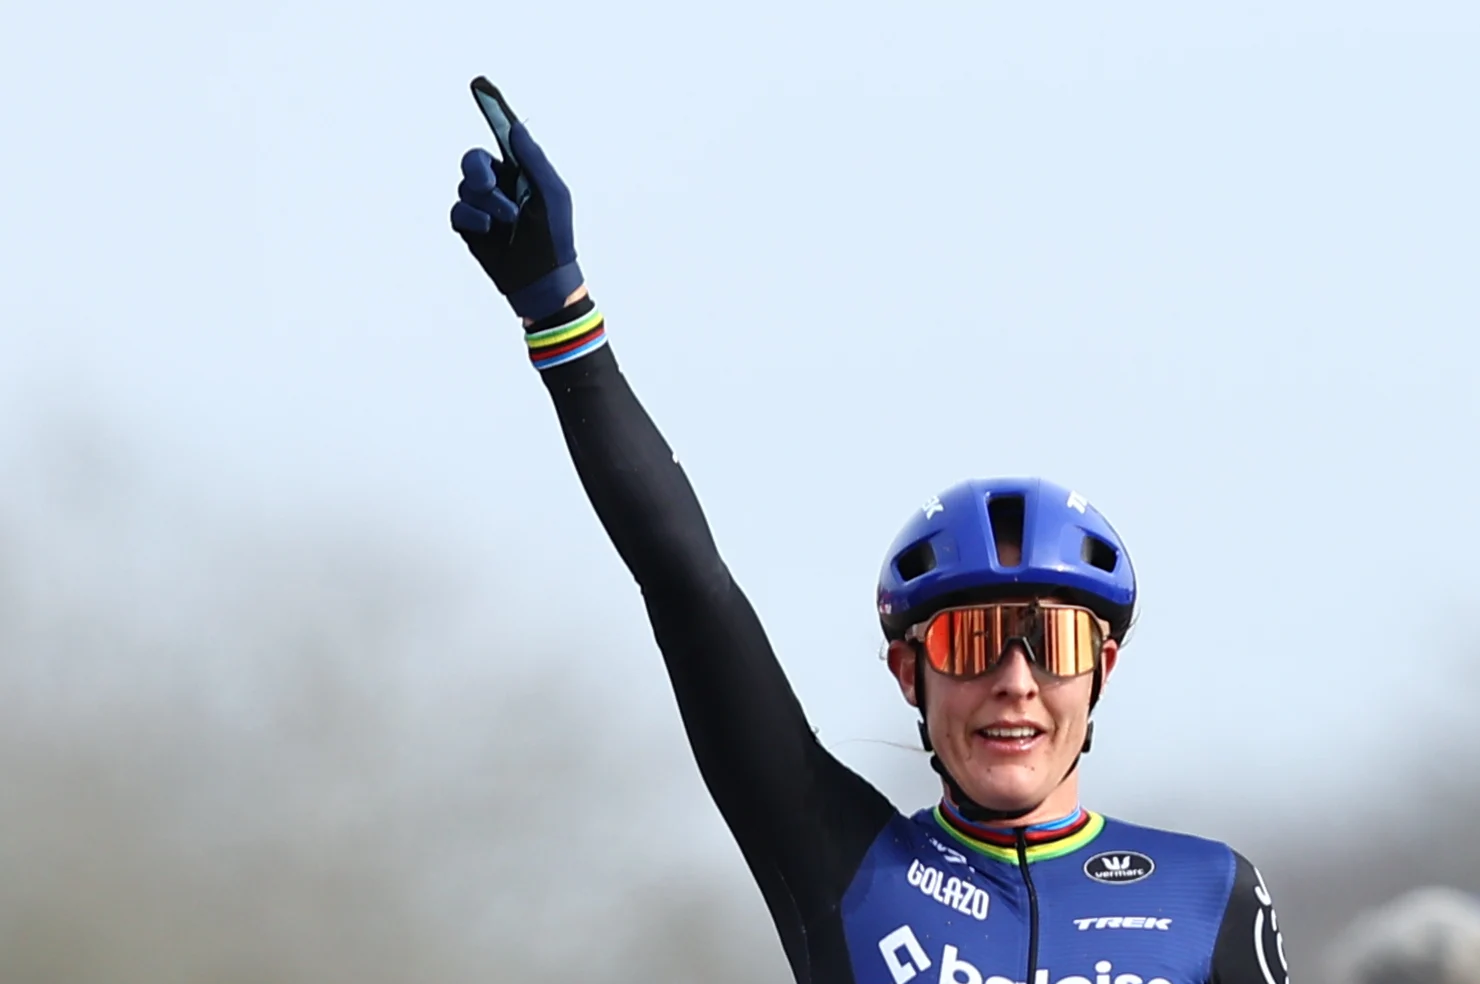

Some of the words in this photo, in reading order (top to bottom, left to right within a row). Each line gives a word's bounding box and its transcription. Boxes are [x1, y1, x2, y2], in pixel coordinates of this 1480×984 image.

[1094, 867, 1144, 879] vermarc
[907, 859, 990, 921] GOLAZO
[1073, 916, 1173, 930] TREK
